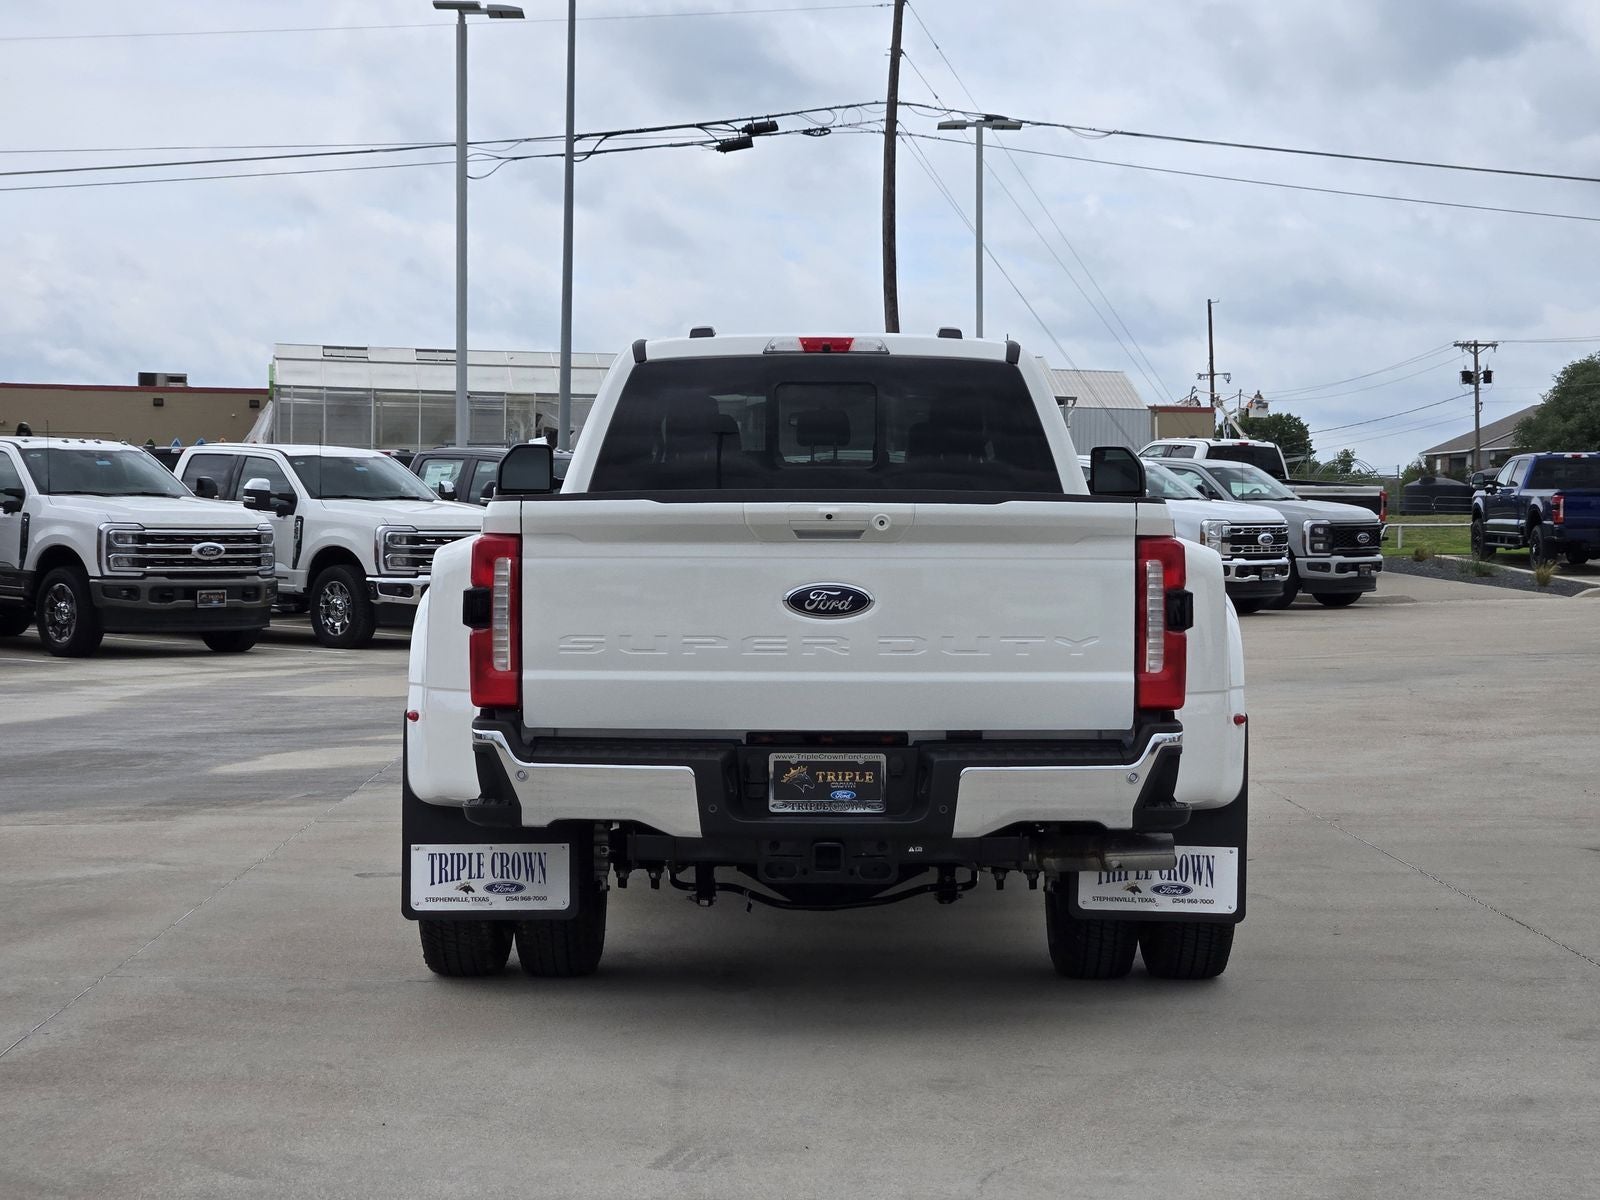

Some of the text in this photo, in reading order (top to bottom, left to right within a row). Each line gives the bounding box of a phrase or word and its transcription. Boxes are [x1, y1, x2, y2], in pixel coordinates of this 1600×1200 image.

[804, 590, 853, 610] Ford
[559, 634, 1100, 656] SUPER DUTY
[815, 771, 874, 784] TRIPLE
[789, 801, 830, 811] TRIPLE
[427, 851, 548, 886] TRIPLE CROWN
[492, 883, 518, 893] Ford
[1159, 885, 1185, 895] Ford
[424, 896, 470, 904] STEPHENVILLE,
[1092, 896, 1137, 904] STEPHENVILLE,
